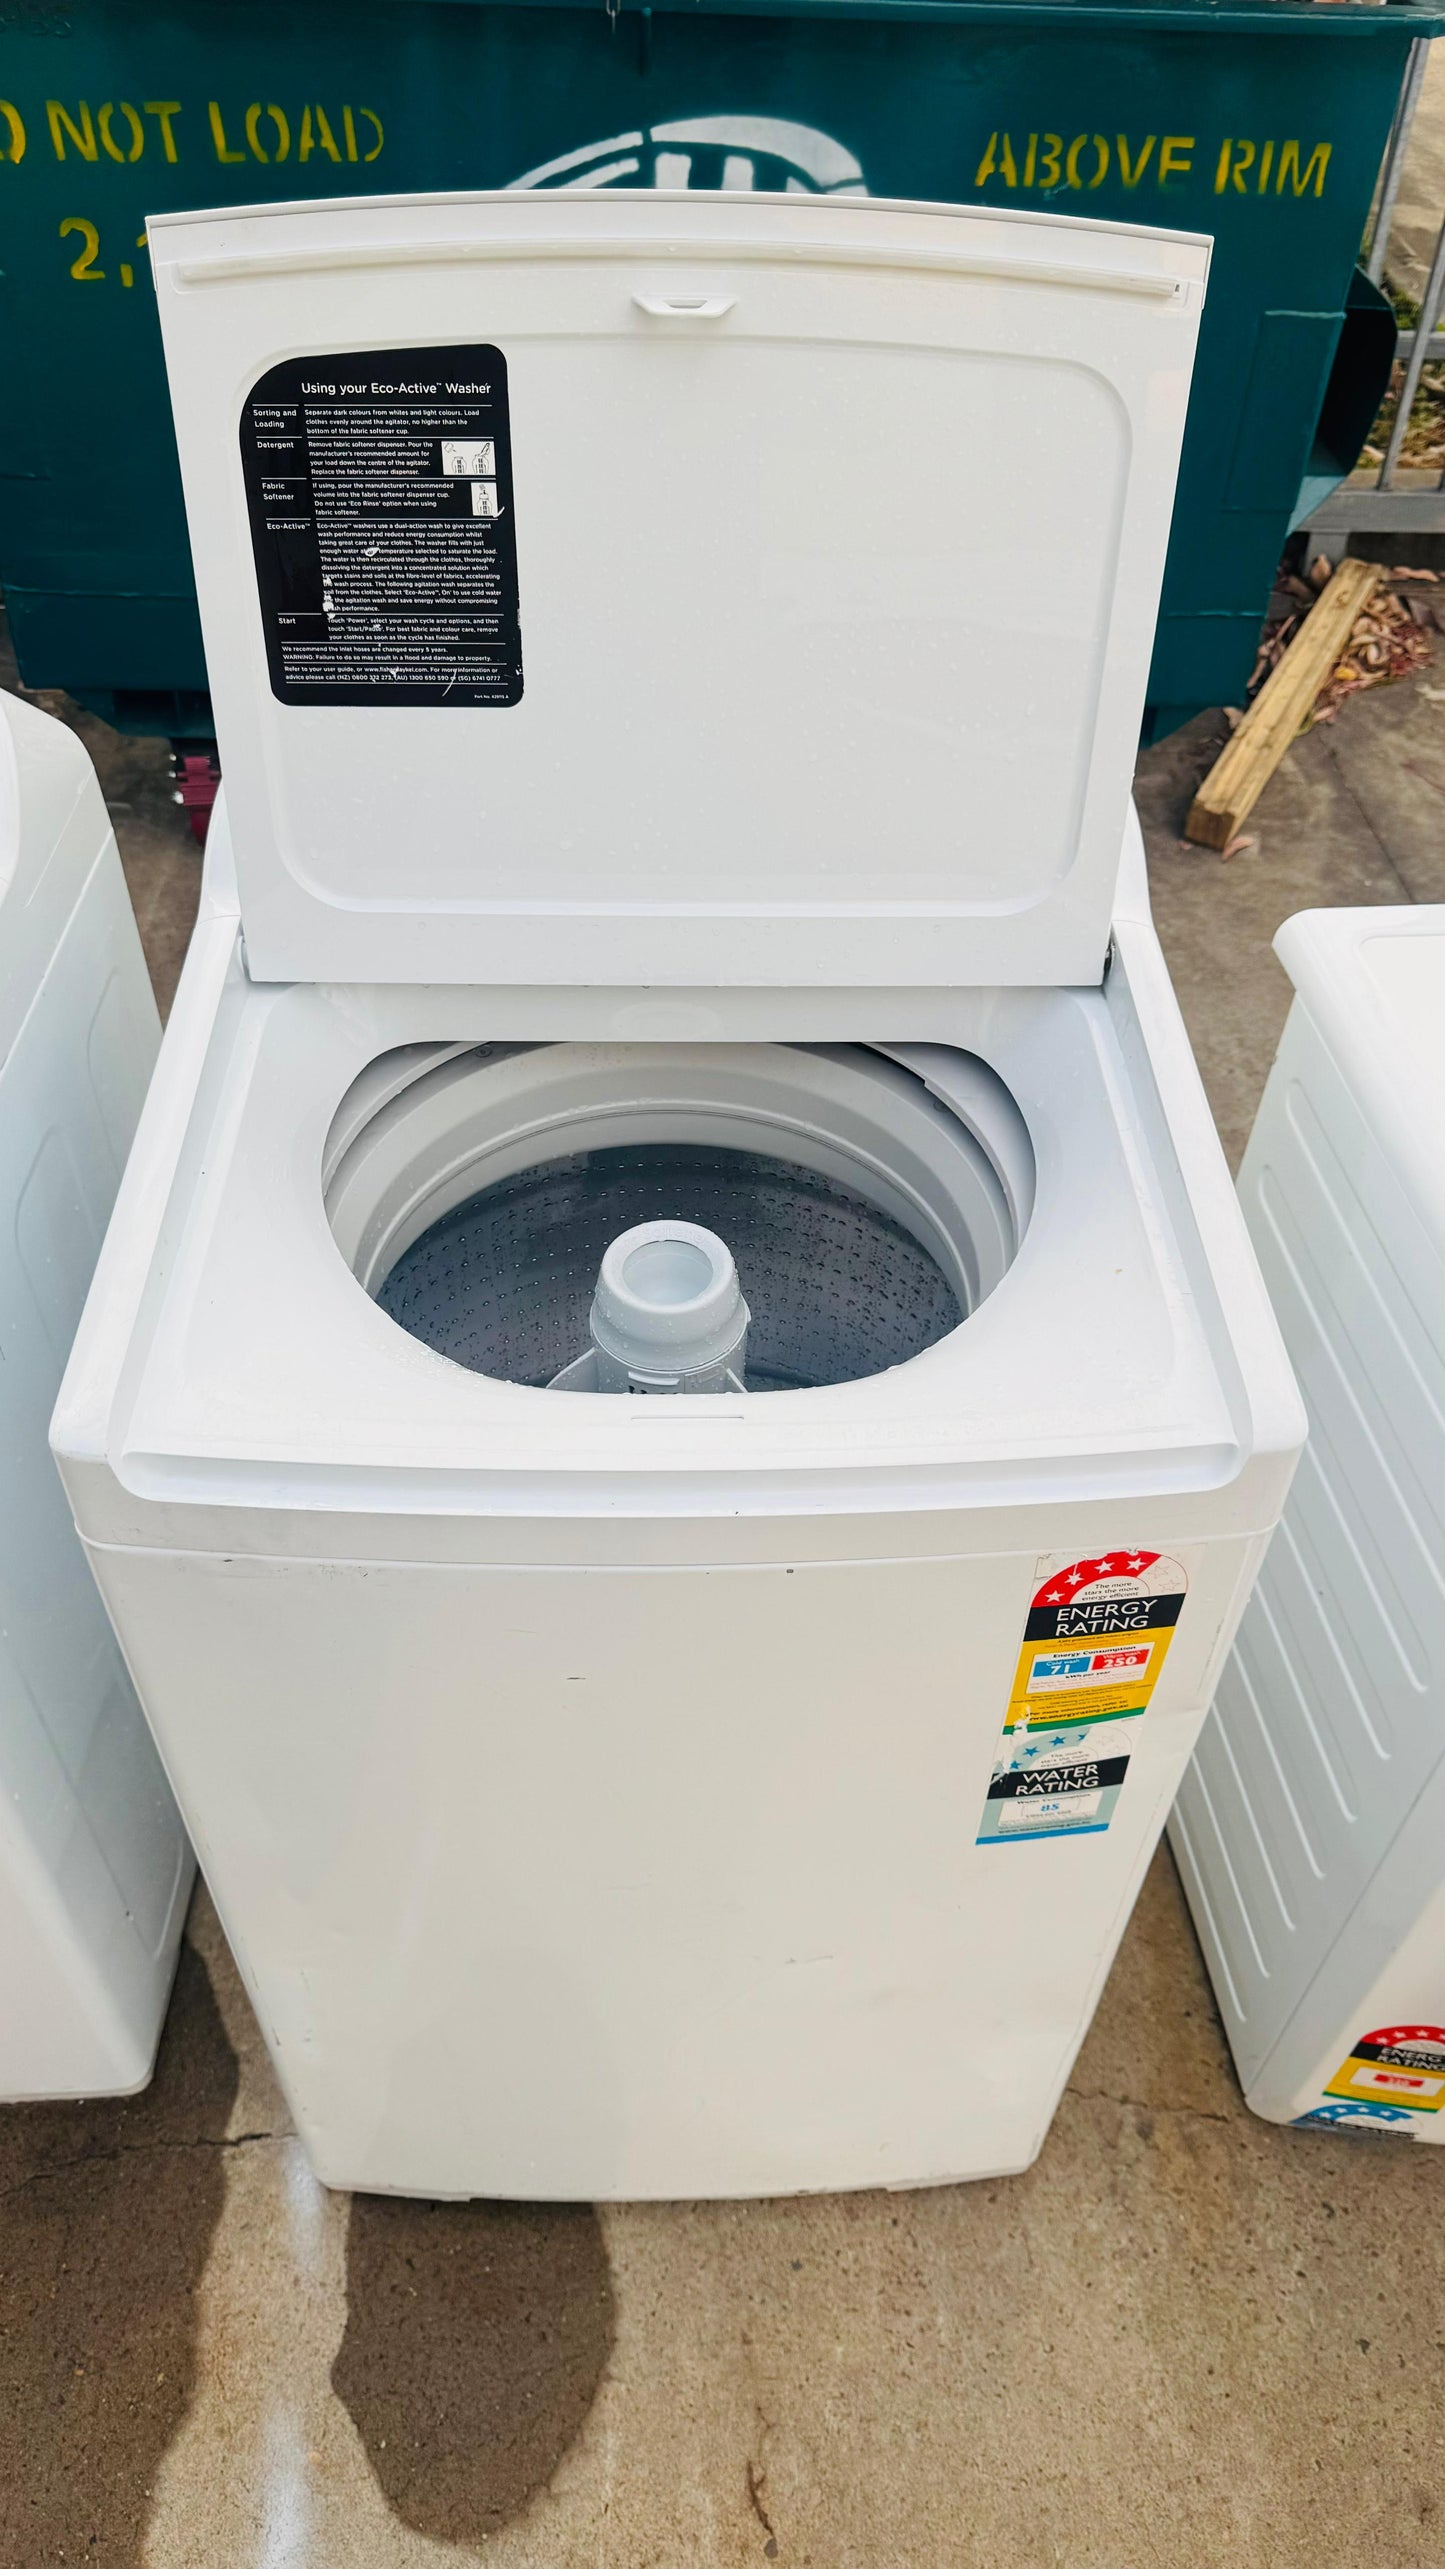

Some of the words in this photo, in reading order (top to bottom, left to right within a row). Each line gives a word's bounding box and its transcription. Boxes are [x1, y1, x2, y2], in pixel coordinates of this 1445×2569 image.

[46, 101, 182, 163] NOT
[209, 101, 384, 163] LOAD
[975, 131, 1195, 190] ABOVE
[1213, 138, 1333, 197] RIM
[301, 382, 335, 395] Using
[340, 385, 367, 395] your
[445, 382, 491, 394] Washer
[252, 408, 280, 418] Sorting
[282, 408, 298, 416] and
[254, 420, 286, 430] Loading
[256, 442, 295, 451] Detergent
[262, 482, 286, 490] Fabric
[318, 482, 336, 490] using,
[1056, 1599, 1158, 1622] ENERGY
[1055, 1615, 1150, 1637] RATING
[1102, 1656, 1138, 1669] 250
[1022, 1764, 1099, 1783] WATER
[1015, 1776, 1100, 1796] RATING
[1381, 2046, 1445, 2063] ENERG
